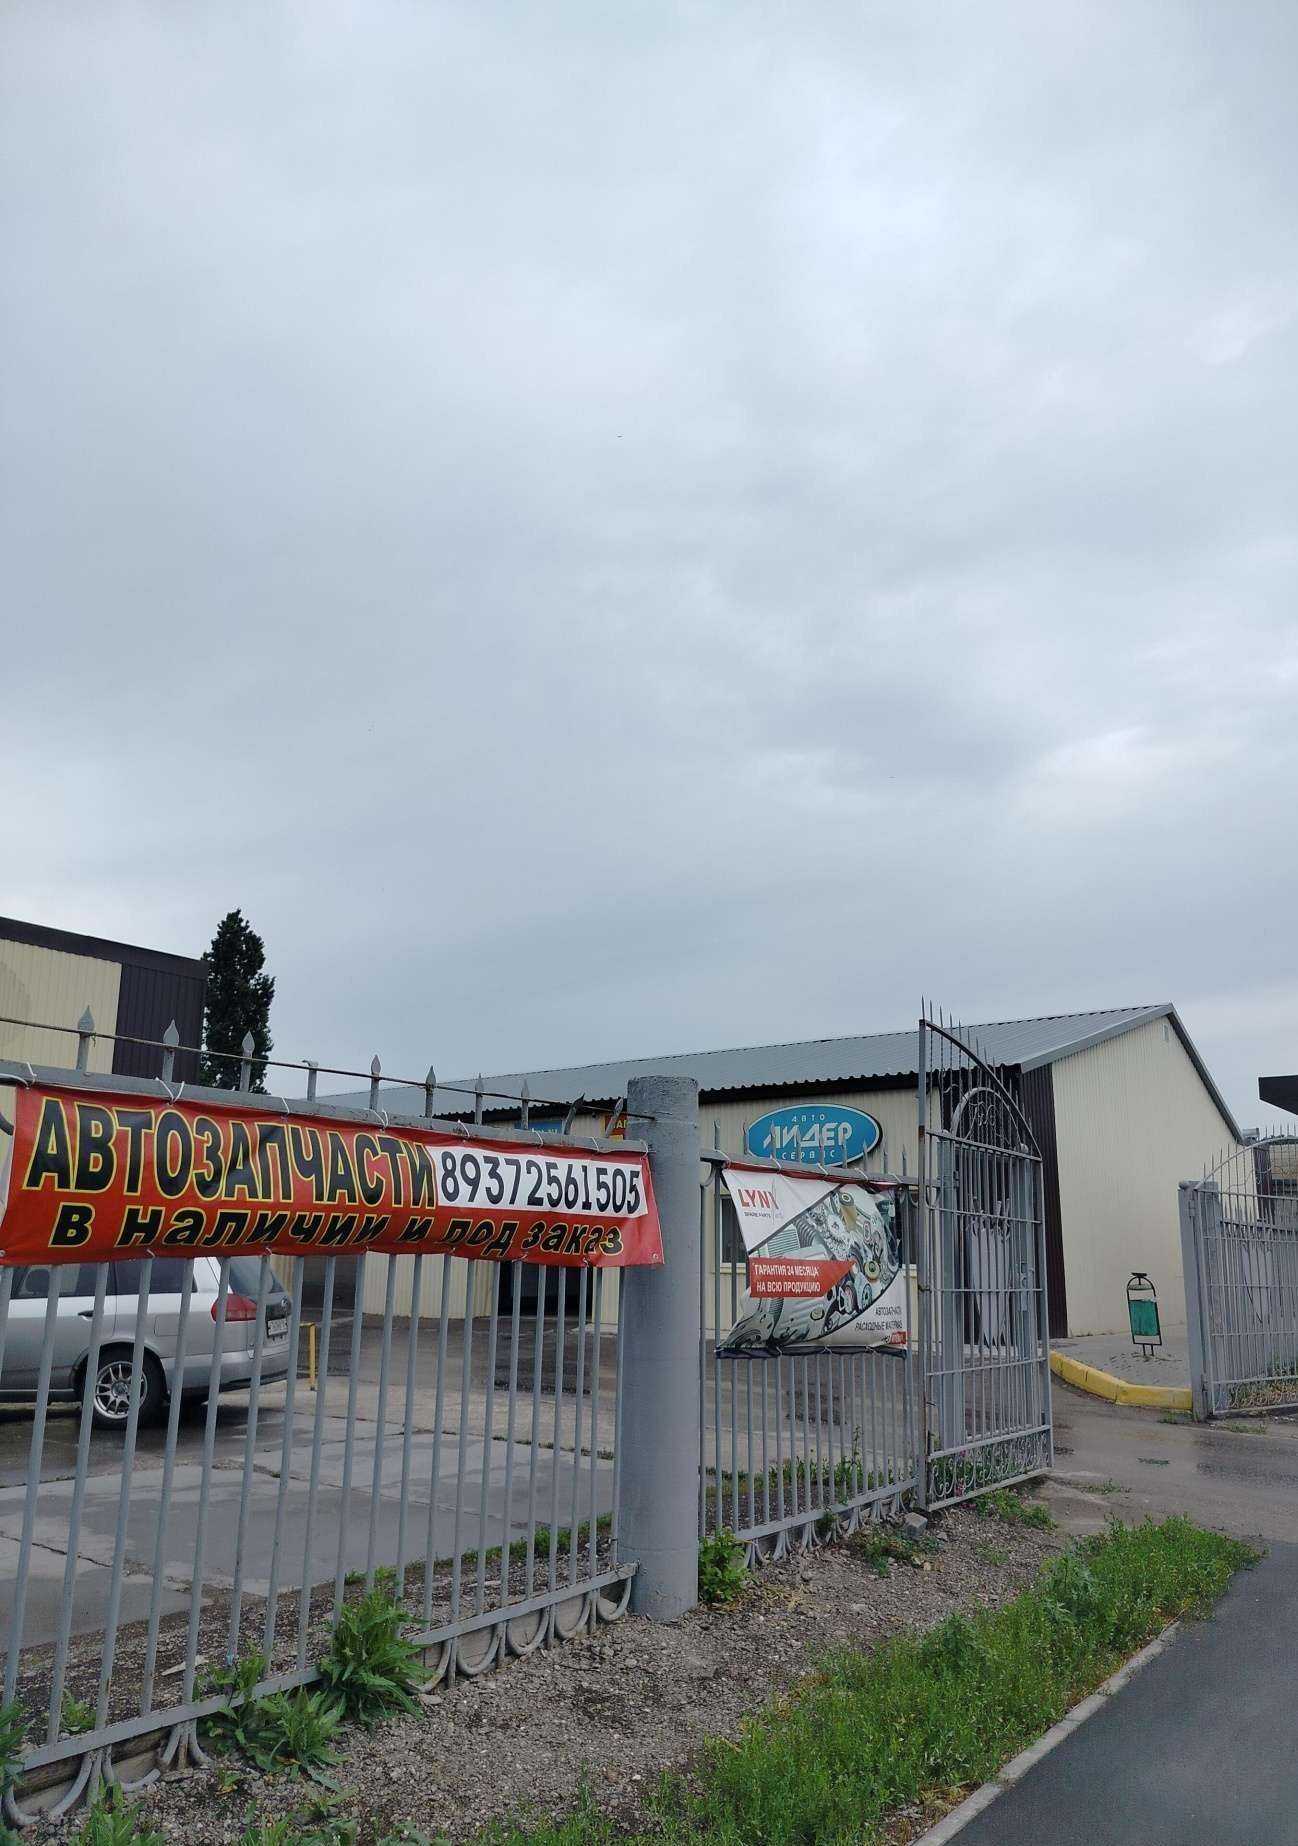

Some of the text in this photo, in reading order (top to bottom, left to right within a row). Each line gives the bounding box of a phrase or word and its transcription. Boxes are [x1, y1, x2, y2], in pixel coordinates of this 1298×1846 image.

[791, 1113, 825, 1123] АВТО
[763, 1122, 852, 1149] ЛИДЕР
[22, 1096, 437, 1210] АВТОЗАПЧАСТИ
[441, 1151, 640, 1214] 89372561505
[113, 1205, 391, 1247] наличии
[396, 1216, 435, 1244] и
[440, 1217, 520, 1257] под
[520, 1219, 624, 1256] заказ
[754, 1264, 786, 1276] ГАРАНТИЯ
[756, 1281, 820, 1294] НА ВСЮ ПРОДУКЦИЮ
